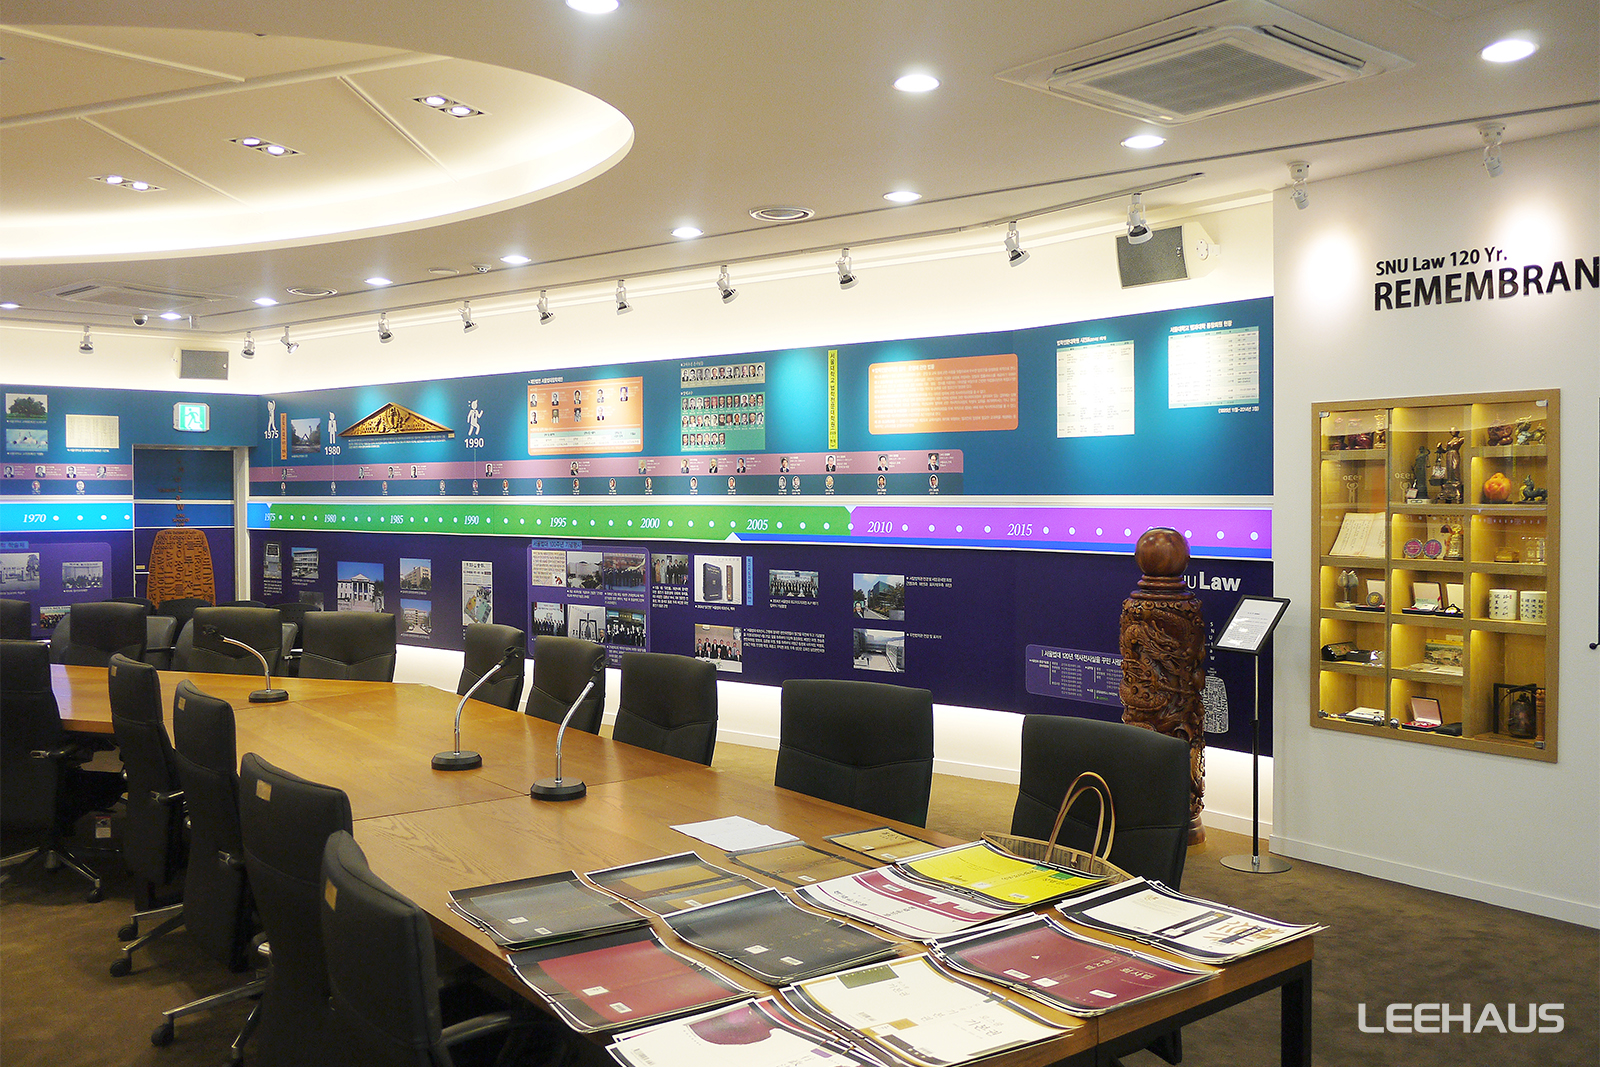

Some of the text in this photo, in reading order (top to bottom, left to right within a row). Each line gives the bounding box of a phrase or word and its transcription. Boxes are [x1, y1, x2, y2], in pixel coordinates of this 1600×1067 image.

[1375, 246, 1508, 276] SNU Law 120 Yr.
[1374, 256, 1600, 311] REMEMBRAN
[264, 430, 279, 439] 1975
[464, 438, 484, 448] 1990
[324, 446, 341, 455] 1980
[22, 513, 47, 523] 1970
[264, 512, 276, 522] 1975
[324, 513, 337, 523] 1980
[389, 514, 404, 524] 1985
[463, 515, 480, 525] 1990
[549, 516, 568, 528] 1995
[639, 517, 660, 530] 2000
[746, 518, 769, 531] 2005
[867, 520, 893, 534] 2010
[1007, 522, 1033, 537] 2015
[1199, 571, 1241, 592] Law
